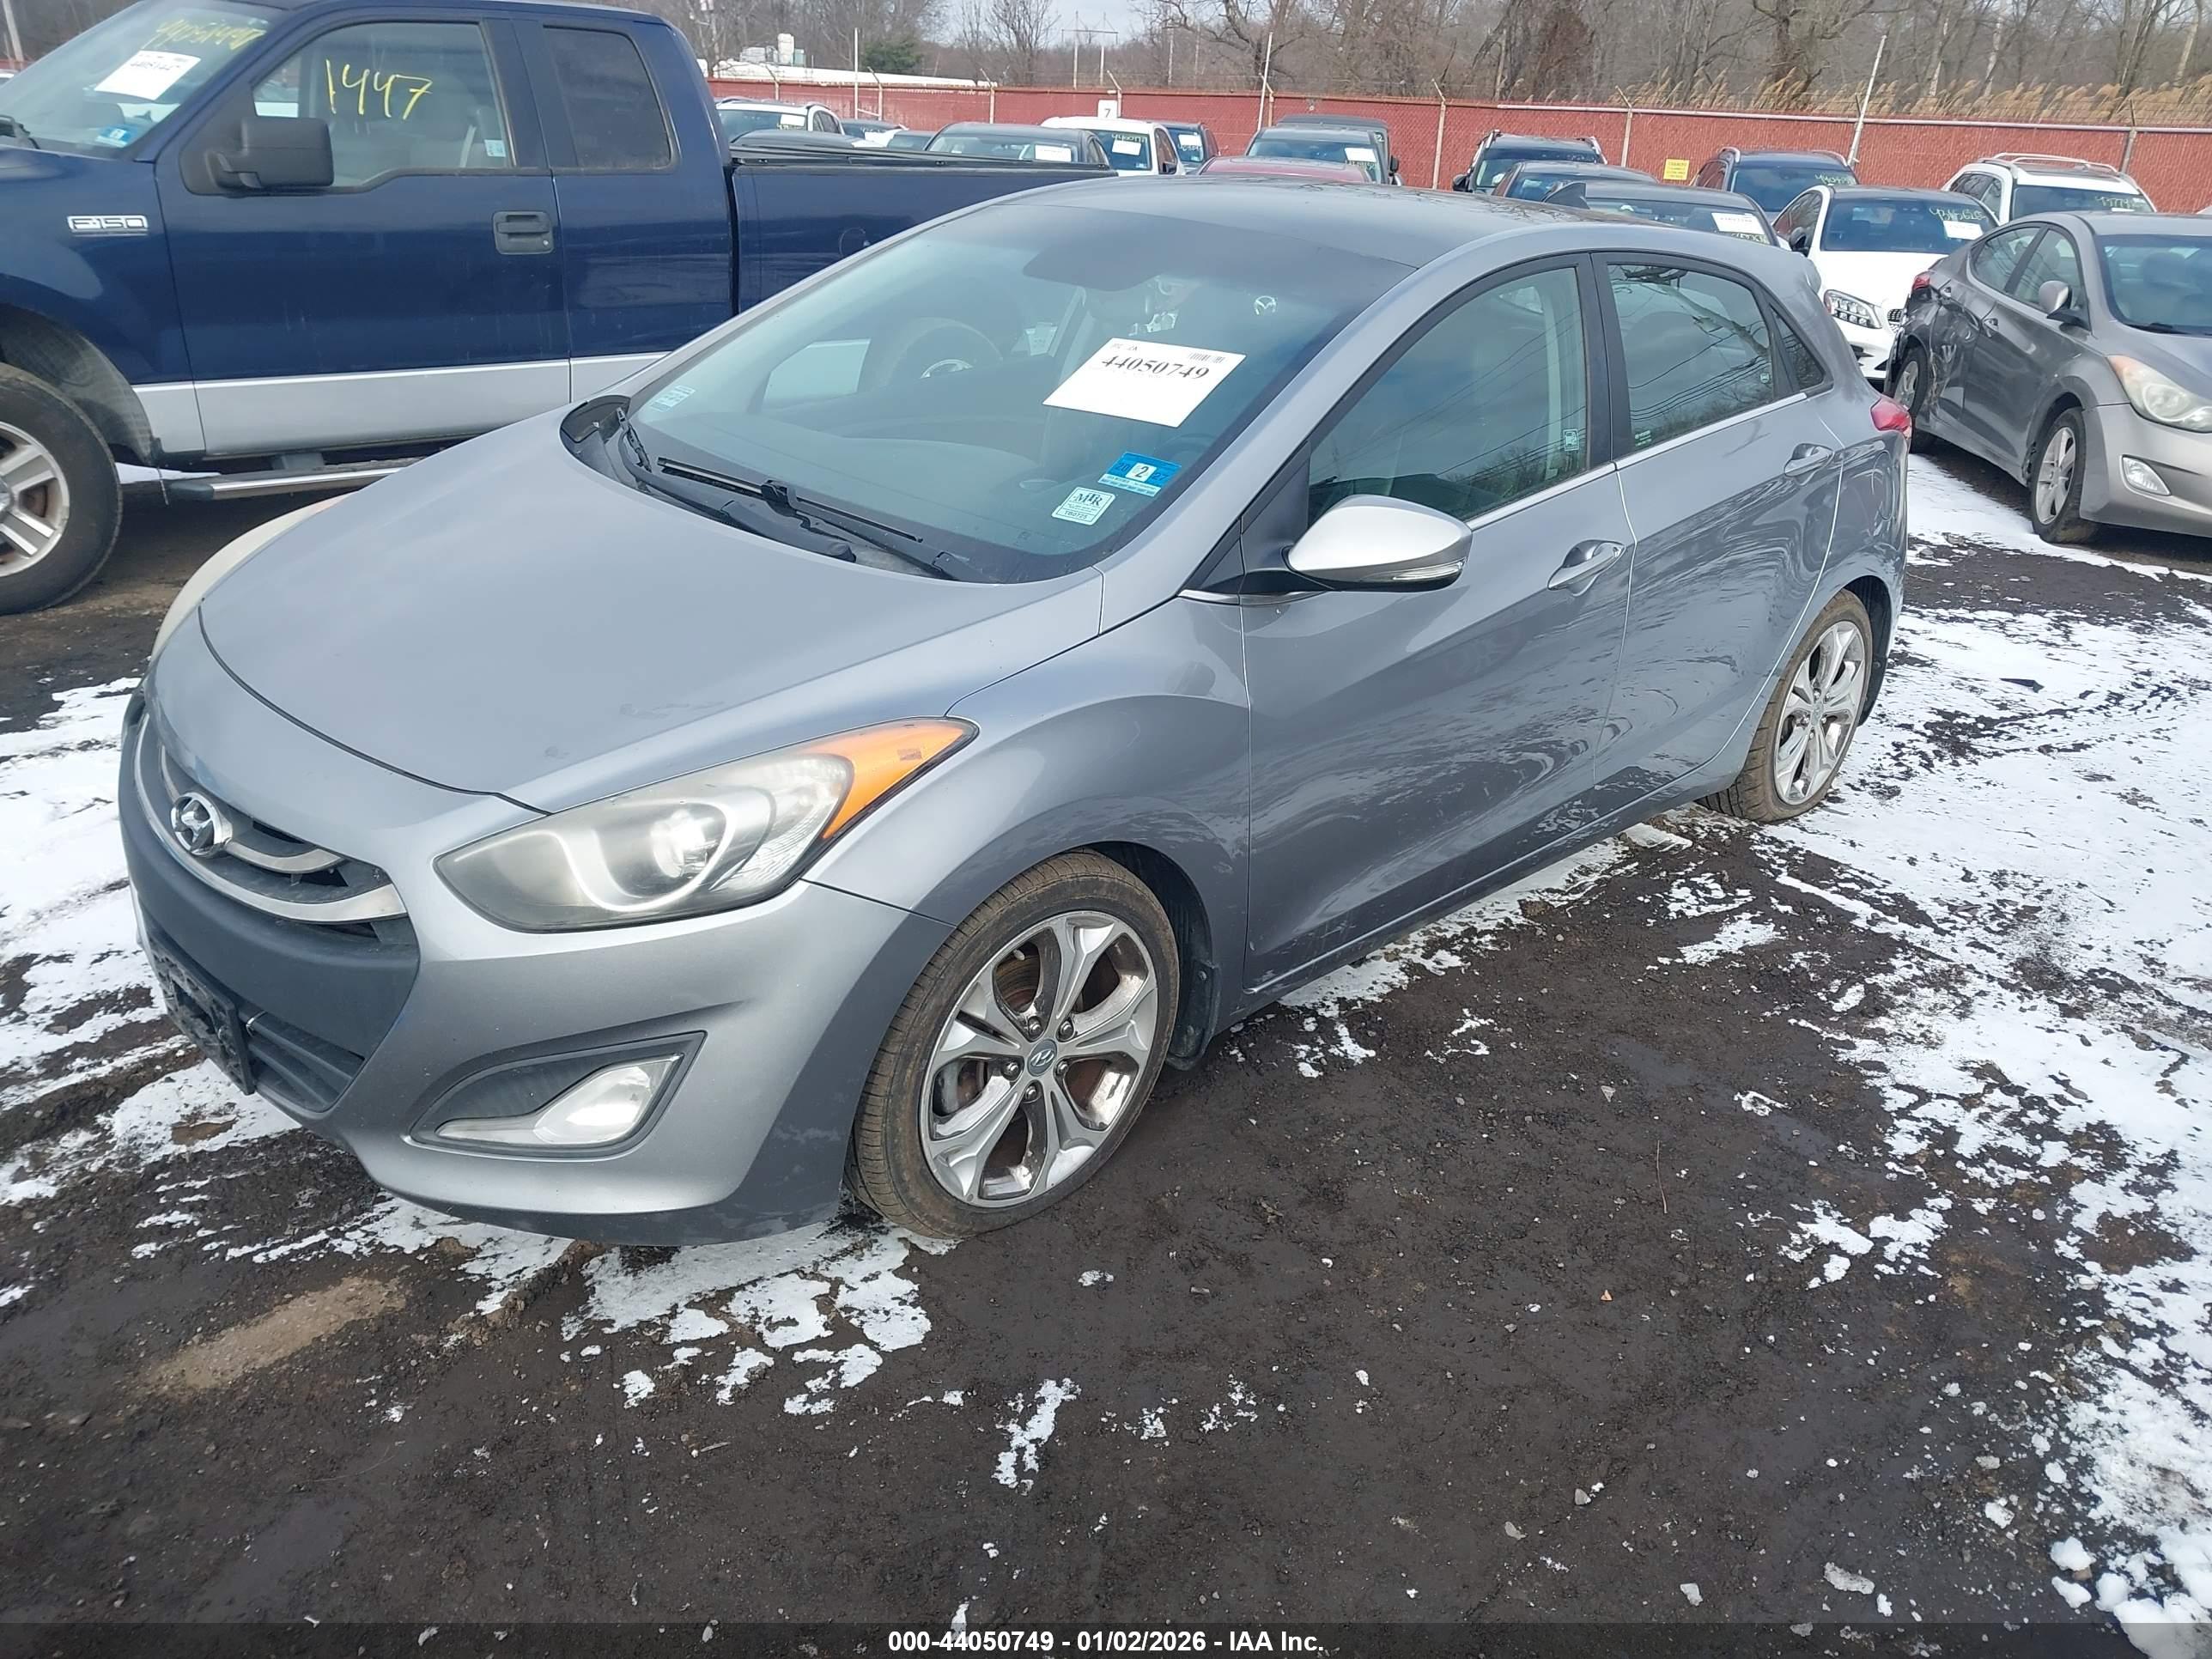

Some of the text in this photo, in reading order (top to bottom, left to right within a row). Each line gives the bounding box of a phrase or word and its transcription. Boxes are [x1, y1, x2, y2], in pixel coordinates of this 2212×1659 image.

[326, 58, 433, 120] 1447
[1104, 108, 1111, 118] 7
[1101, 356, 1210, 380] 44050749
[1134, 465, 1149, 478] 2
